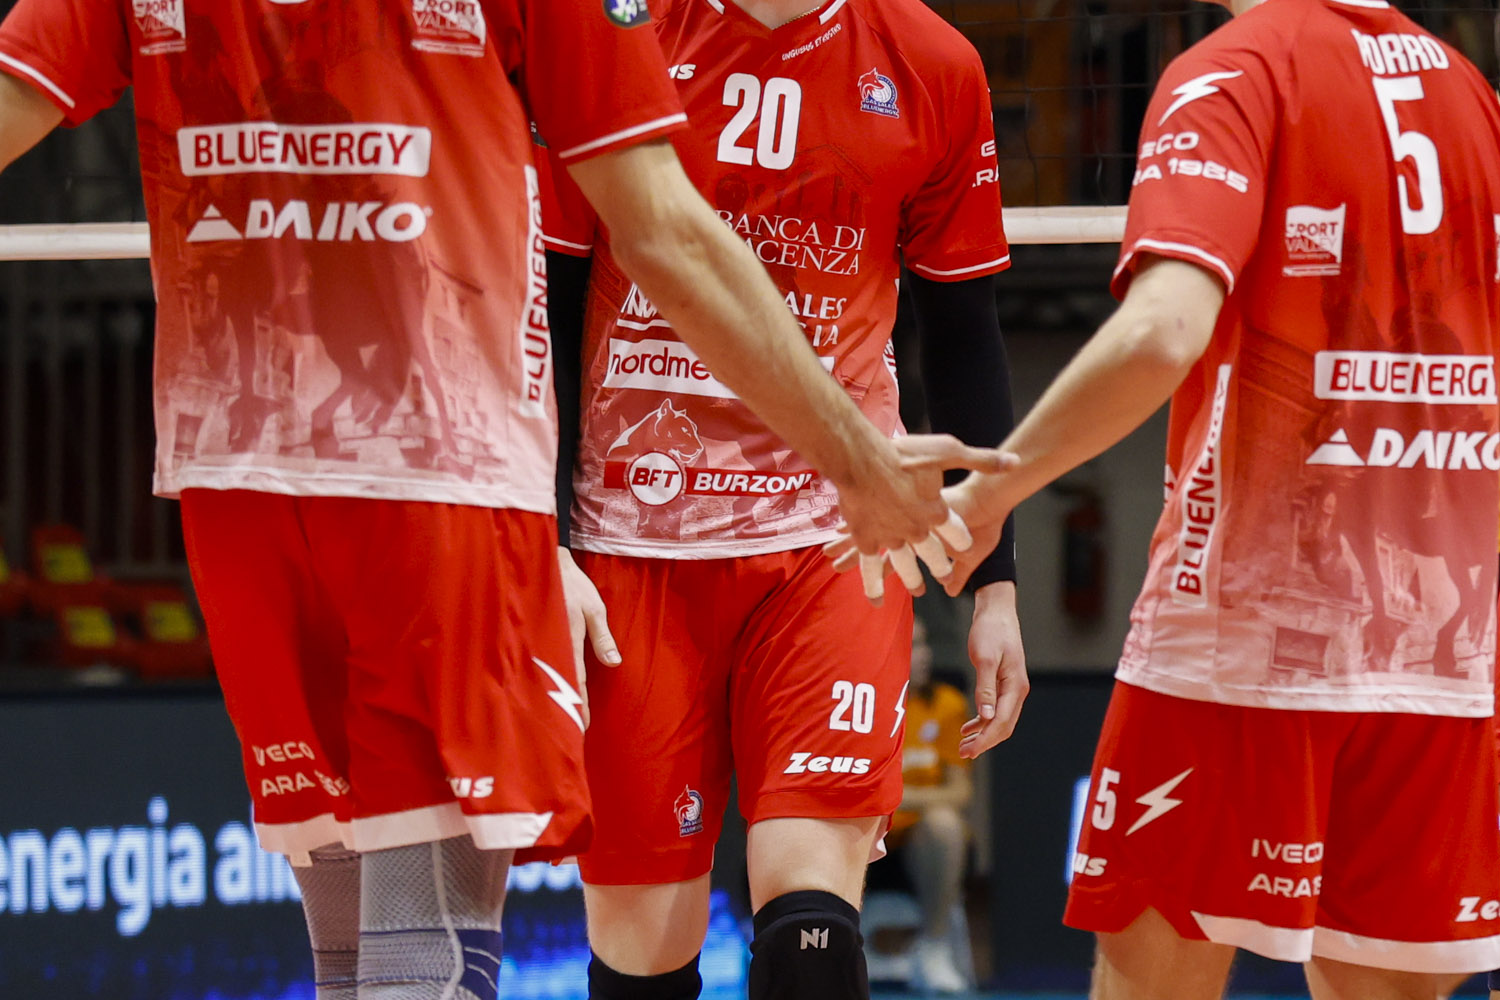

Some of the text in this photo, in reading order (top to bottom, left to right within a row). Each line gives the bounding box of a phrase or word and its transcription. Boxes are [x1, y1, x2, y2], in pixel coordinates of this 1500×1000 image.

[717, 72, 801, 170] 20
[194, 130, 414, 167] BLUENERGY
[1372, 76, 1444, 235] 5
[1167, 157, 1249, 193] 1965
[245, 200, 427, 241] DAIKO
[831, 226, 866, 250] DI
[1330, 359, 1497, 396] BLUENERG
[632, 468, 679, 488] BFT
[829, 680, 875, 734] 20
[783, 753, 871, 774] Zeus
[262, 772, 315, 797] ARA
[1092, 767, 1120, 831] 5
[0, 796, 207, 936] nergia
